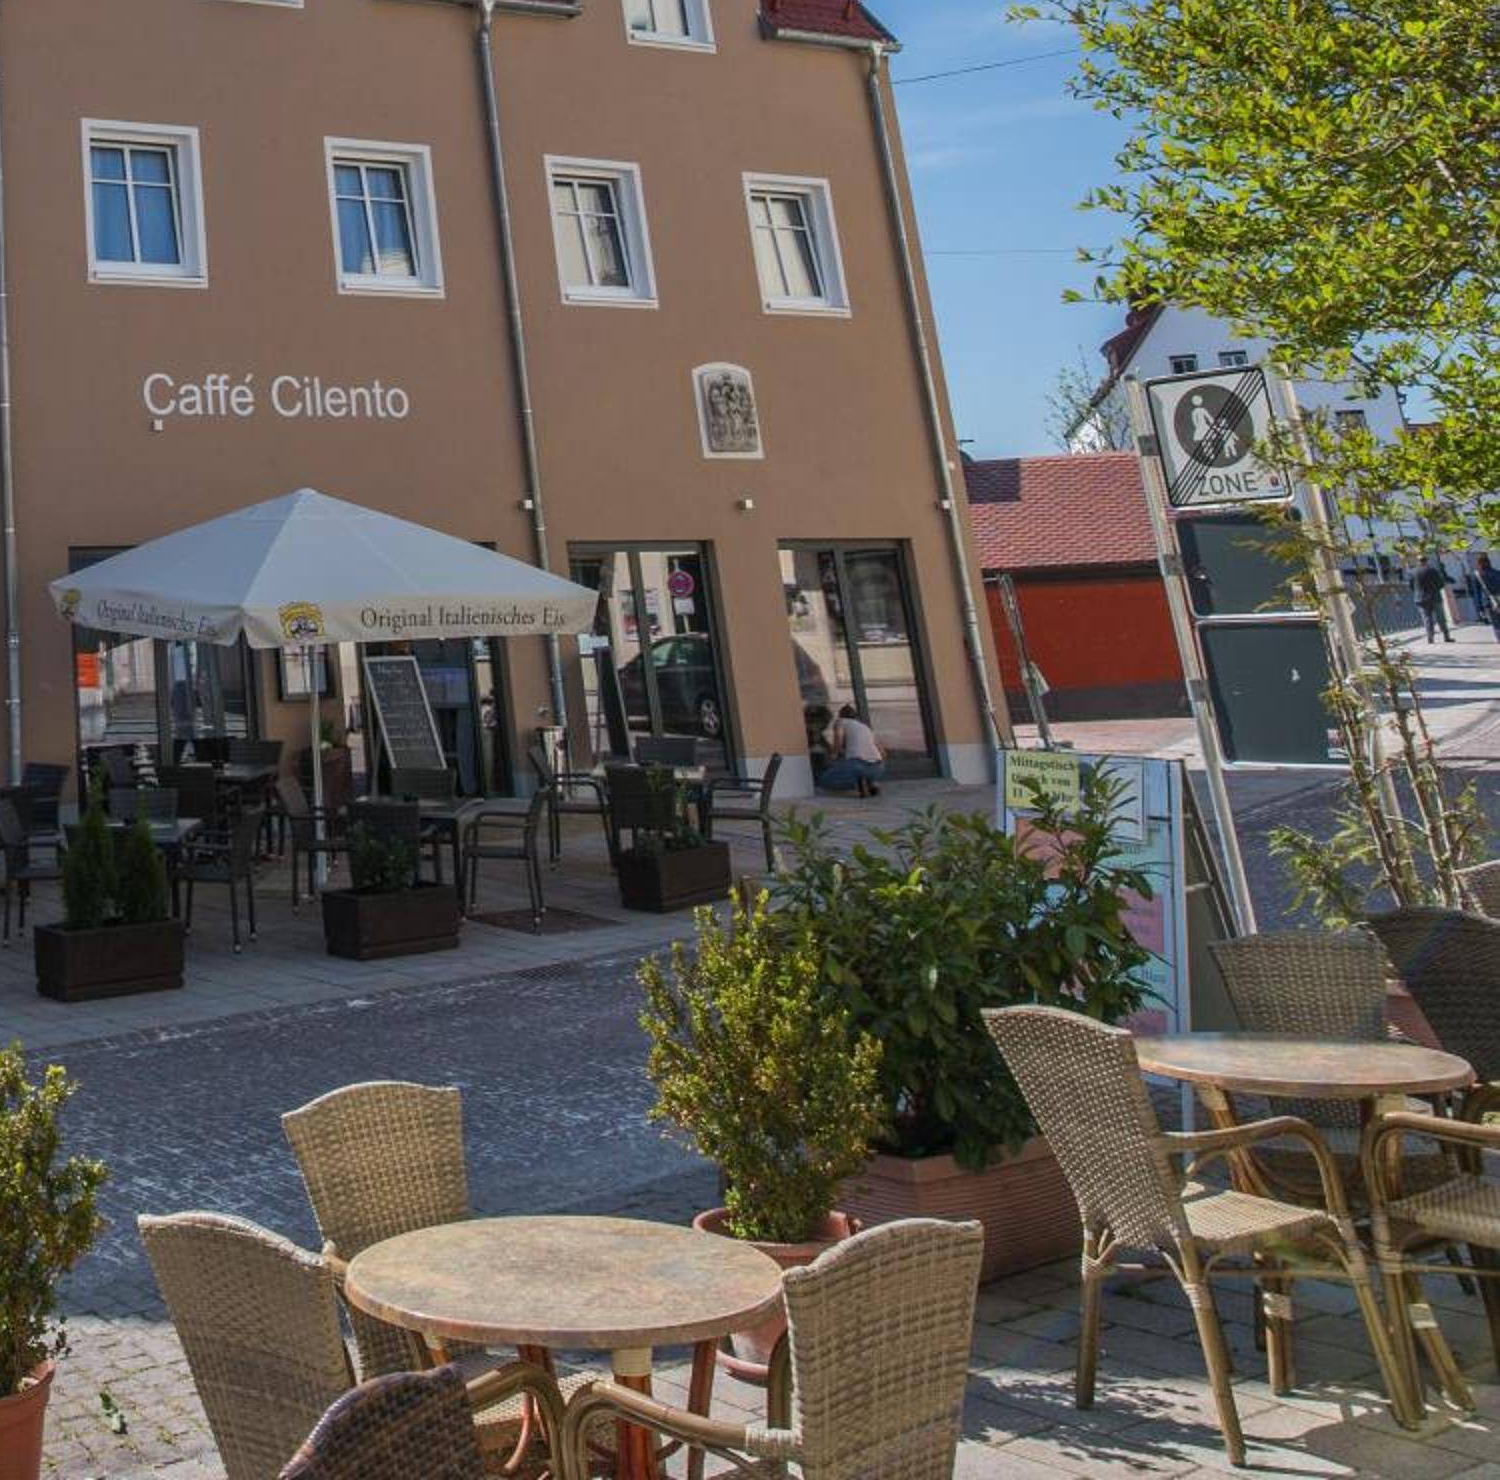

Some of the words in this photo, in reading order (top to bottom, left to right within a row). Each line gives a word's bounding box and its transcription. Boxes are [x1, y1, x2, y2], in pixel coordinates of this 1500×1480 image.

[143, 372, 255, 416] Caffé
[271, 375, 409, 418] Cilento
[1198, 471, 1259, 496] ZONE
[361, 605, 432, 634] Original
[438, 605, 536, 627] Italienisches
[542, 606, 566, 627] Eis
